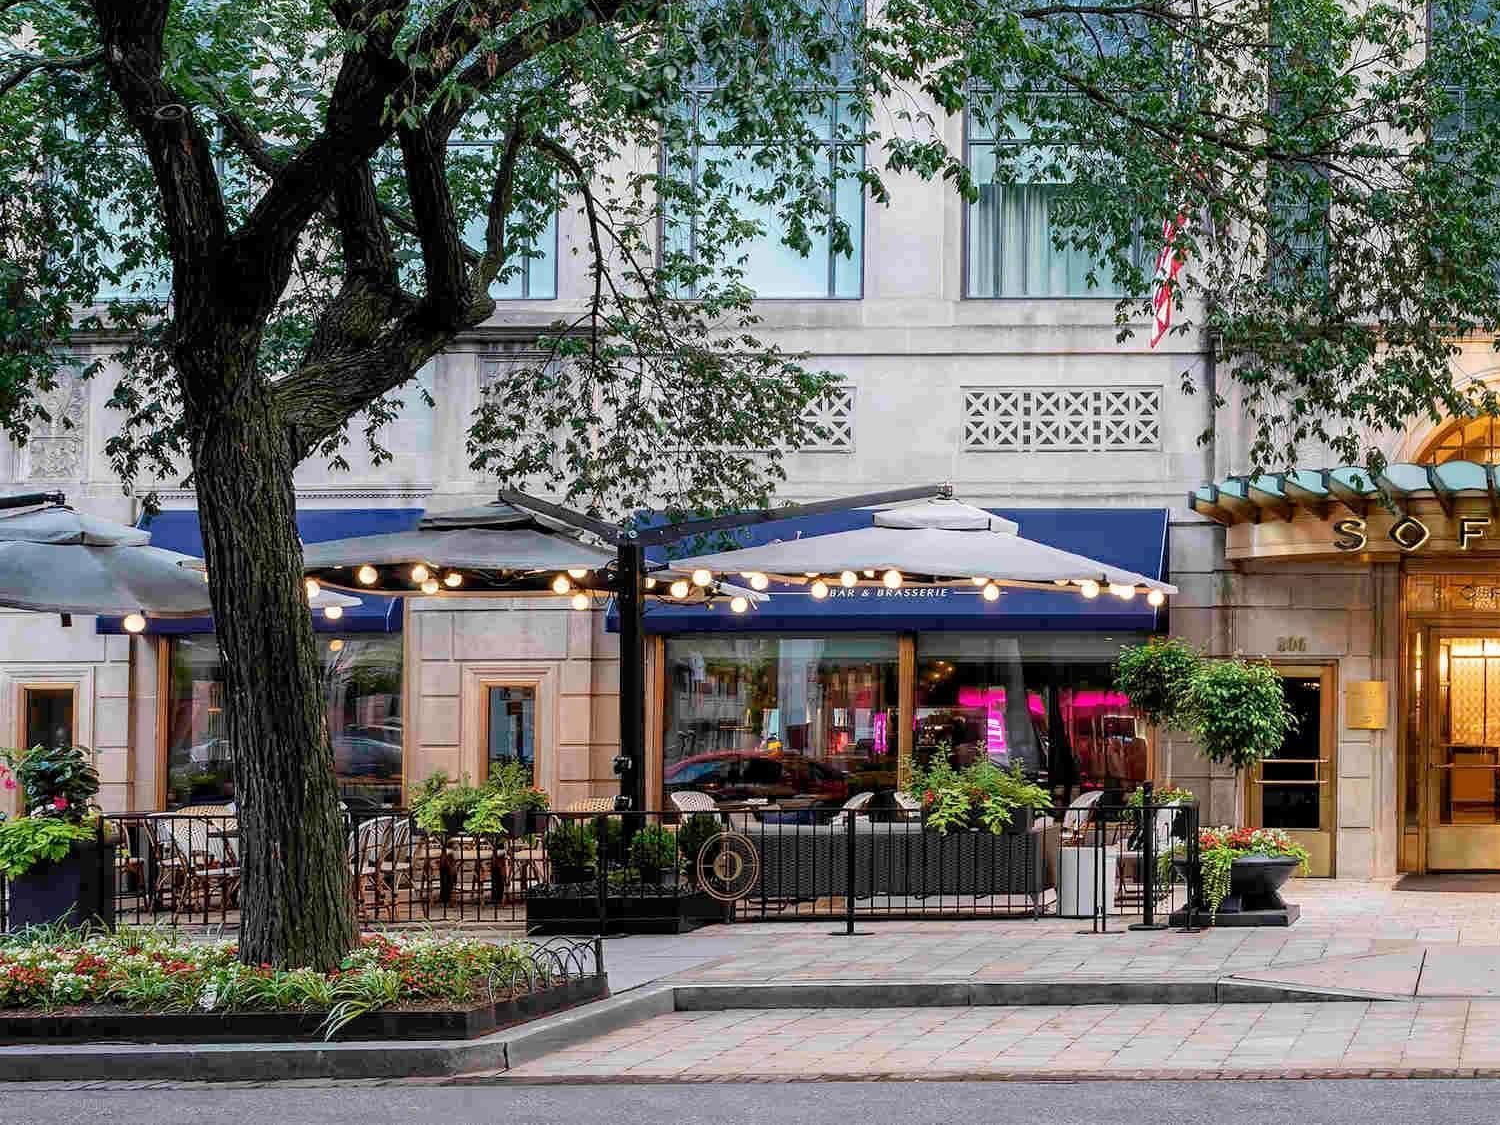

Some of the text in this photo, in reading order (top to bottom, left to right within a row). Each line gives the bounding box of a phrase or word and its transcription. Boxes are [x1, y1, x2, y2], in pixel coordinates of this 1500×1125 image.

[829, 587, 949, 597] BAR & BRASSERIE
